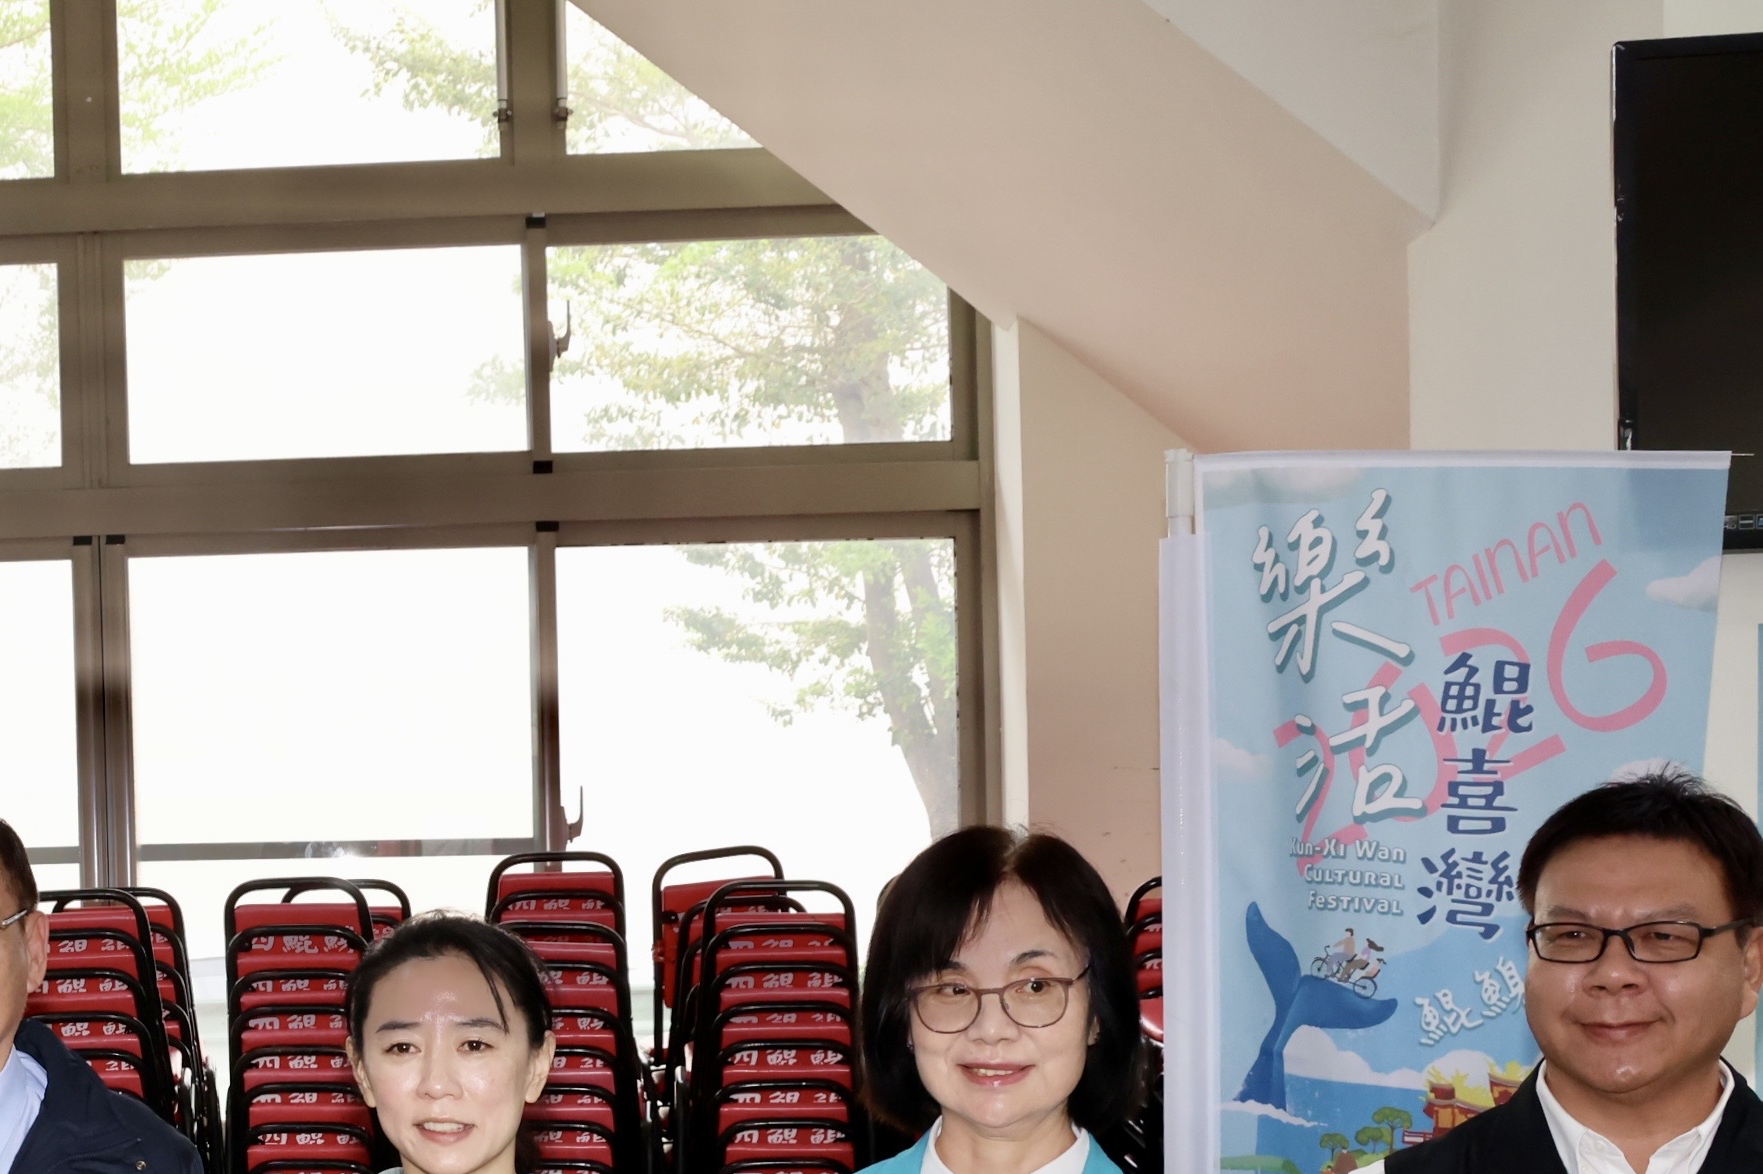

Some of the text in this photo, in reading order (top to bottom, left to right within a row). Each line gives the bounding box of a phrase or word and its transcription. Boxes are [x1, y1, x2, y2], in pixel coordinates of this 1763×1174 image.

[1252, 489, 1431, 824] 樂活
[1410, 502, 1602, 626] TAINAN
[1355, 840, 1407, 864] Wan
[1417, 651, 1534, 940] 鯤喜灣
